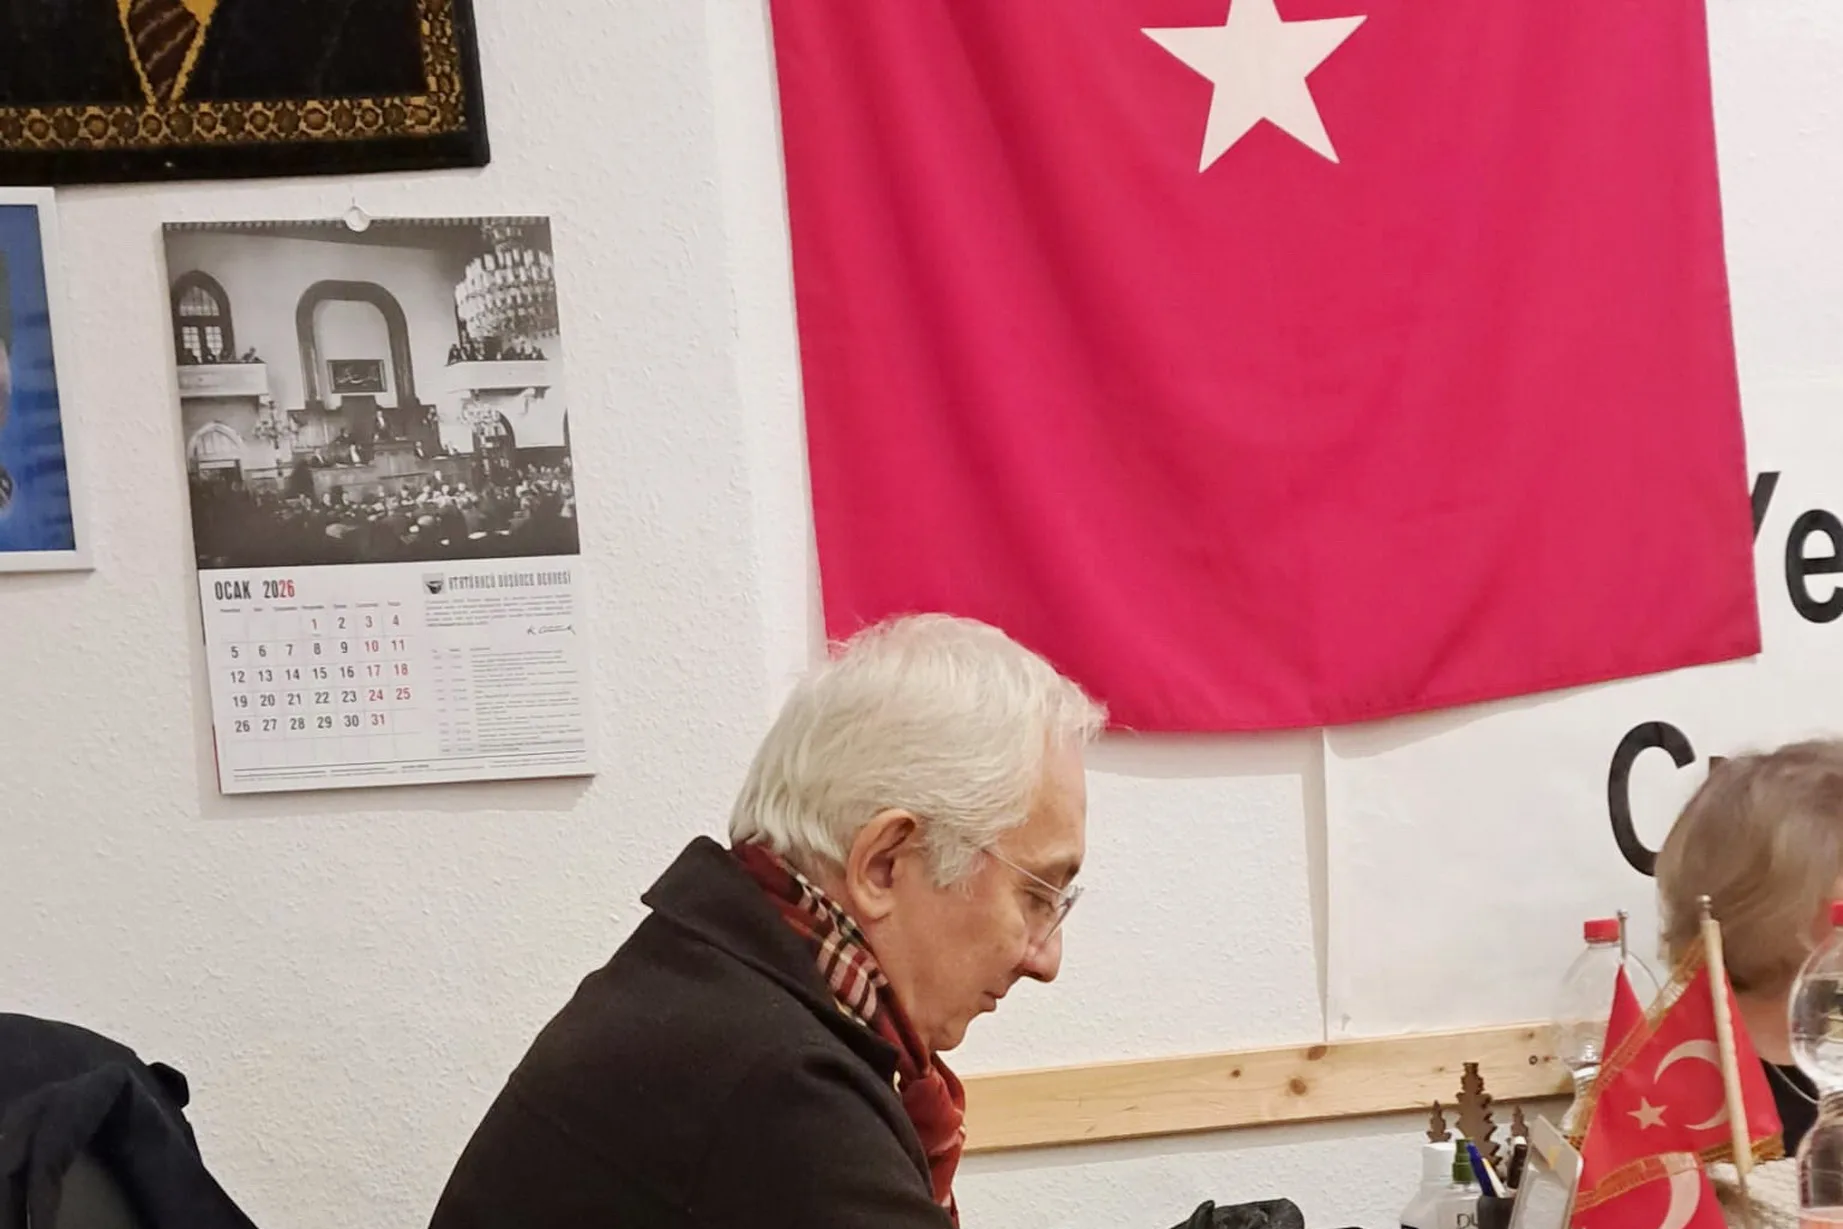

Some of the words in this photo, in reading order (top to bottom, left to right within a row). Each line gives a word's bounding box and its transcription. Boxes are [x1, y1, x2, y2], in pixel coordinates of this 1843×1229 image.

[214, 580, 251, 600] OCAK
[262, 579, 295, 599] 2026
[311, 618, 317, 630] 1
[338, 617, 346, 629] 2
[365, 615, 373, 628] 3
[393, 614, 400, 626] 4
[231, 646, 239, 658] 5
[259, 644, 266, 657] 6
[286, 644, 293, 656] 7
[314, 643, 321, 655] 8
[340, 642, 348, 653] 9
[365, 640, 379, 652] 10
[391, 639, 405, 651] 11
[230, 671, 245, 683] 12
[258, 669, 272, 682] 13
[286, 668, 300, 681] 14
[312, 667, 327, 680] 15
[339, 666, 355, 678] 16
[367, 665, 380, 677] 17
[394, 664, 408, 675] 18
[233, 695, 247, 708] 19
[260, 694, 275, 707] 20
[287, 693, 301, 705] 21
[315, 692, 330, 704] 22
[341, 690, 357, 703] 23
[369, 689, 383, 701] 24
[396, 688, 411, 700] 25
[235, 720, 250, 732] 26
[262, 719, 277, 731] 27
[290, 717, 305, 730] 28
[317, 716, 332, 729] 29
[344, 715, 359, 727] 30
[371, 714, 385, 726] 31
